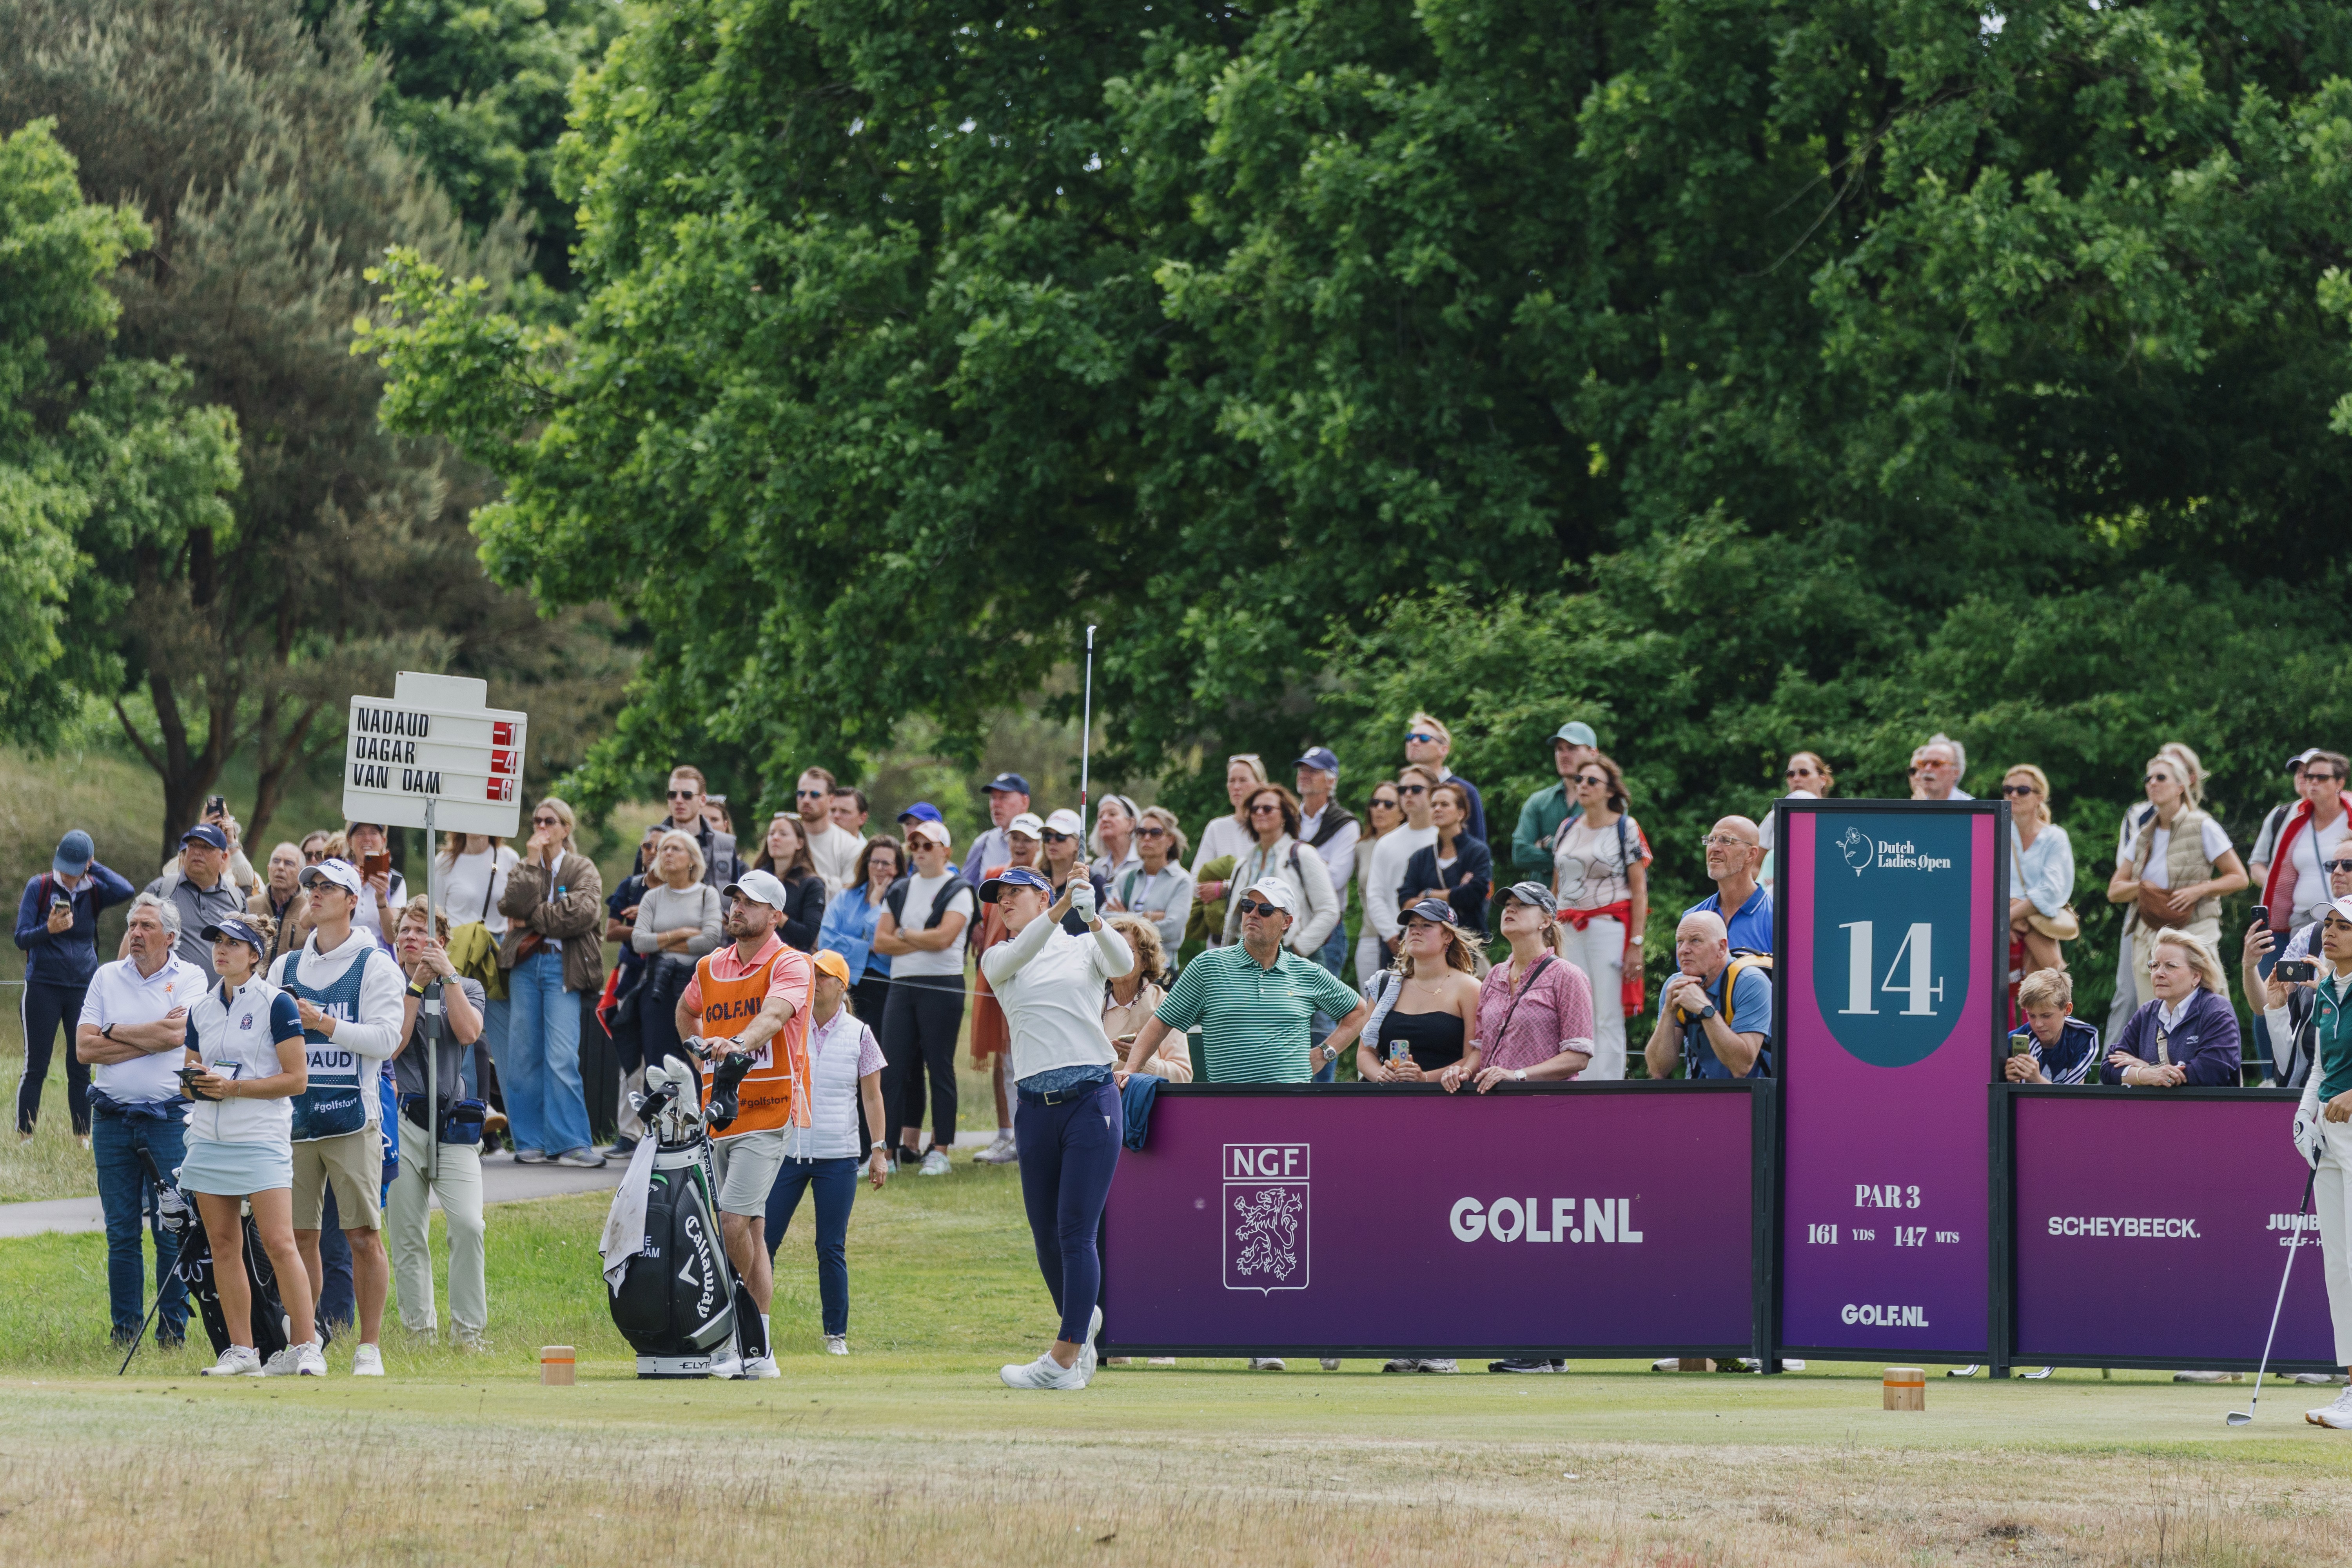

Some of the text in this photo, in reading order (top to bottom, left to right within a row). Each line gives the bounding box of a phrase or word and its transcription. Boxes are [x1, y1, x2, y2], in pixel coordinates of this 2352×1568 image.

[357, 708, 429, 737] NADAUD
[356, 736, 415, 764] DAGAR
[354, 764, 512, 802] VAN DAM -6
[1878, 840, 1915, 854] Dutch
[1878, 854, 1916, 868] Ladies
[1029, 875, 1051, 892] CHROME
[1838, 921, 1943, 1016] 14
[306, 1051, 352, 1068] AUD
[740, 1095, 788, 1109] #golfstart
[1234, 1148, 1299, 1176] NGF
[1855, 1185, 1921, 1209] PAR 3
[1450, 1197, 1643, 1243] GOLF.NL
[2048, 1216, 2201, 1238] SCHEYBEECK.
[1807, 1224, 1960, 1247] 161 YDS 147 MTS
[685, 1215, 714, 1318] Callaway
[1841, 1304, 1929, 1327] GOLF.NL
